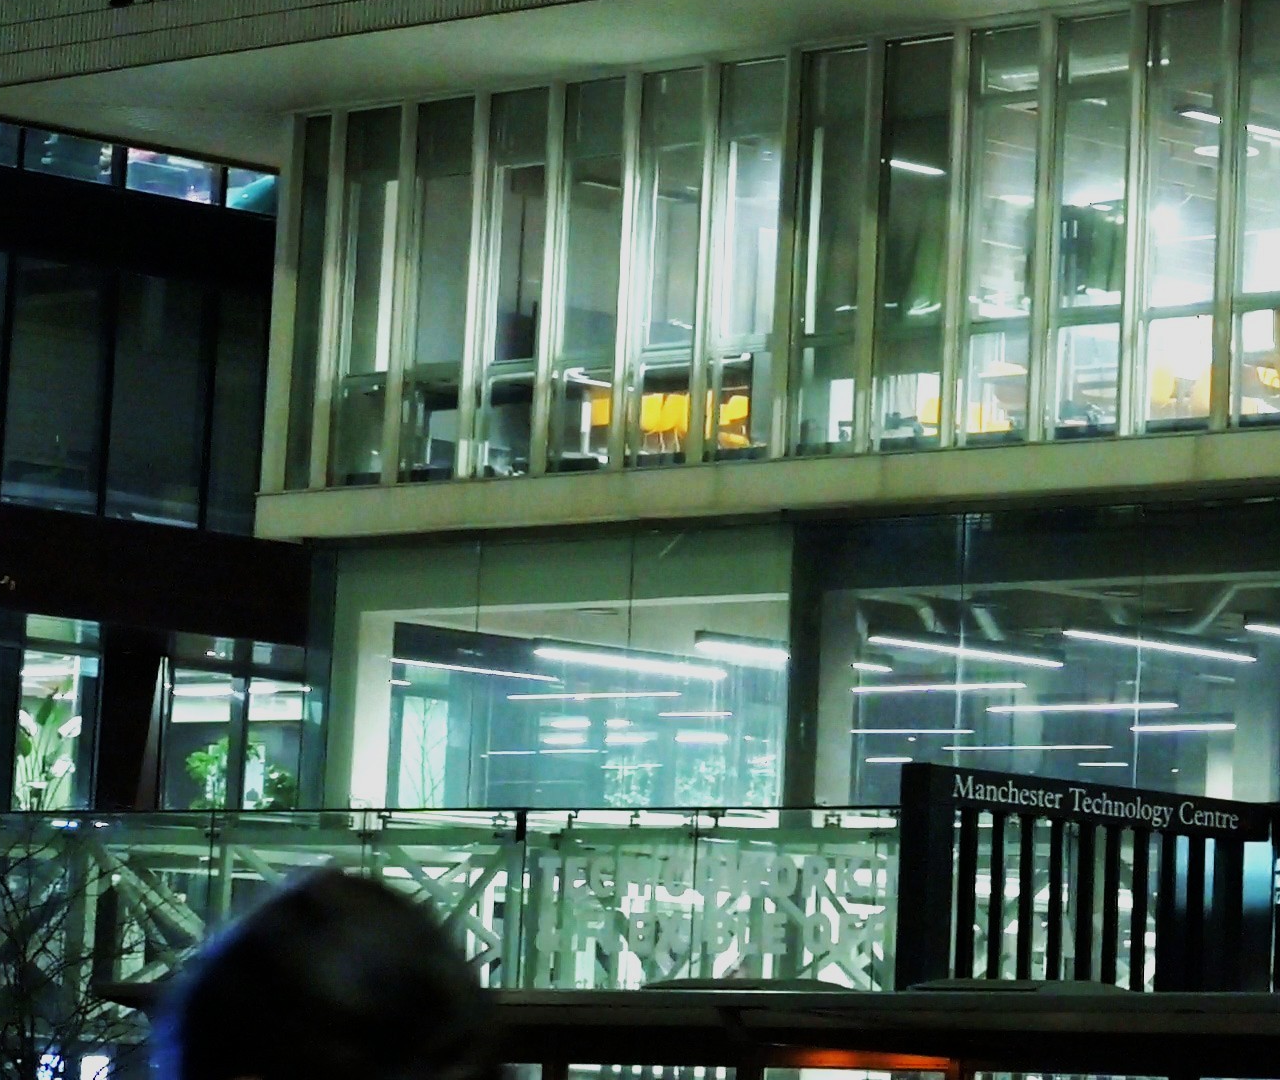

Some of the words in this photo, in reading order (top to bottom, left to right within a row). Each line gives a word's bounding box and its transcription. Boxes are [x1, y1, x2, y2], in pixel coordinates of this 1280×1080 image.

[952, 774, 1063, 809] Manchester
[1069, 787, 1173, 827] Technology
[1179, 801, 1240, 830] Centre
